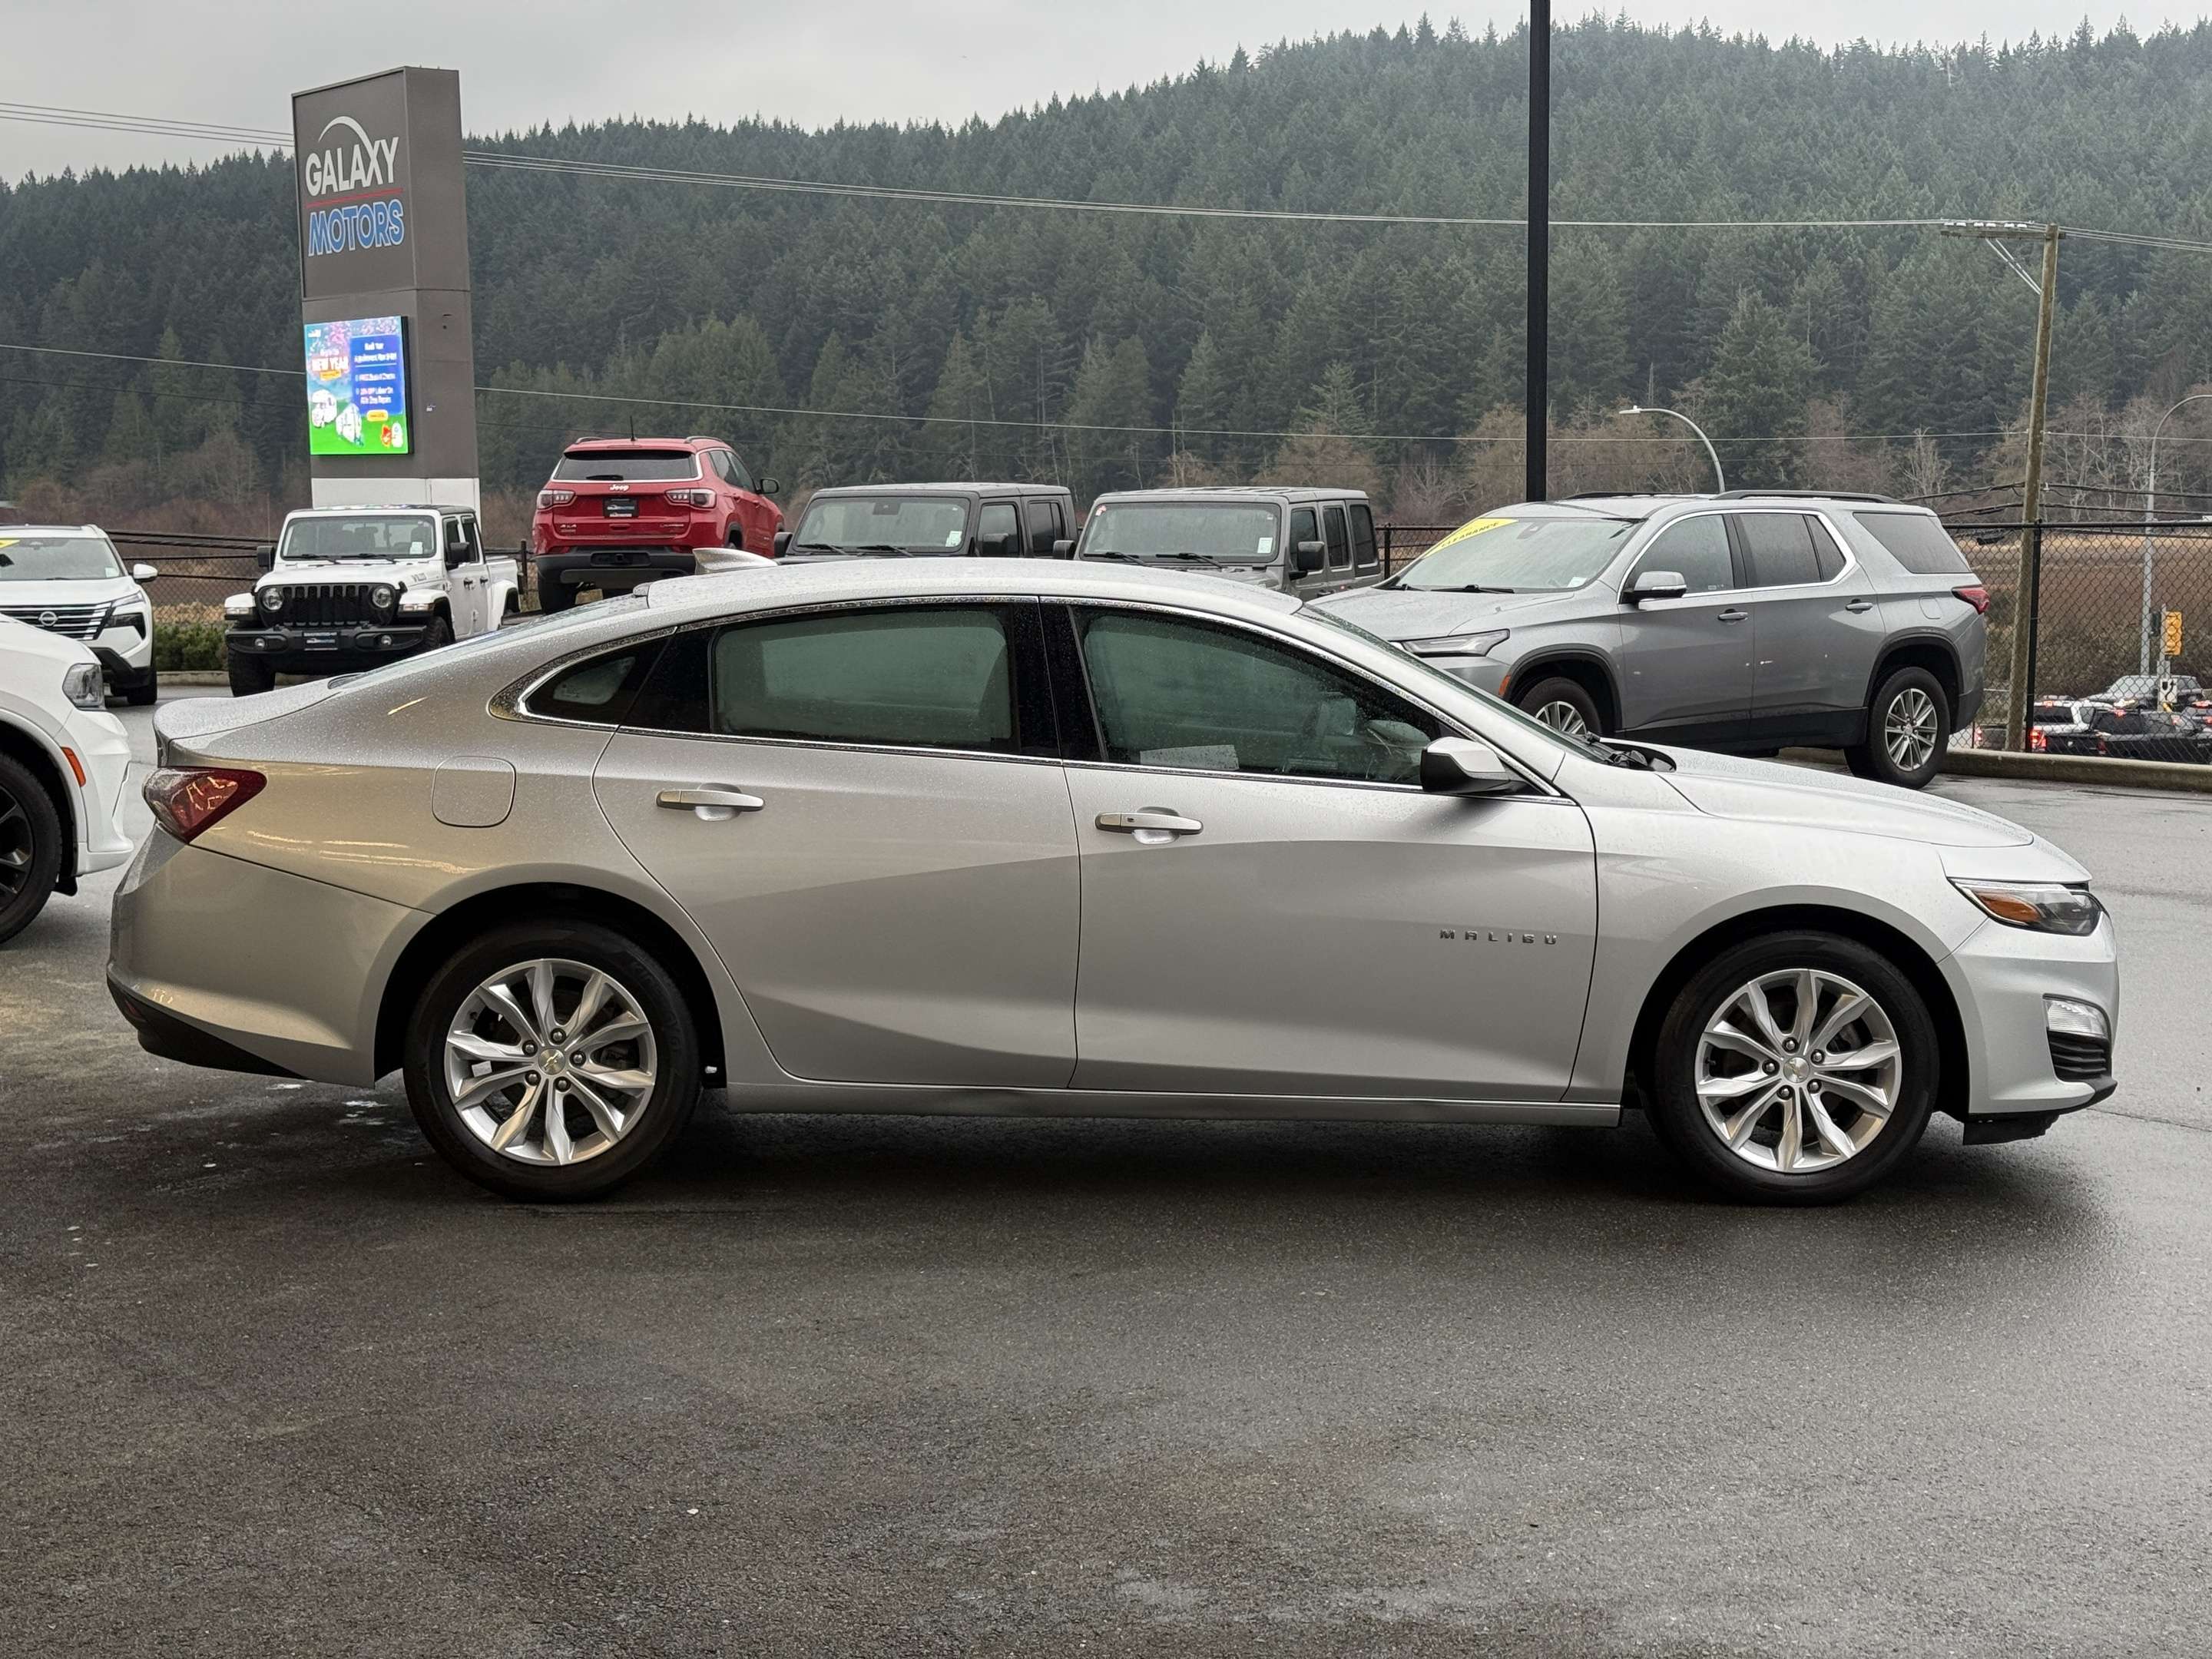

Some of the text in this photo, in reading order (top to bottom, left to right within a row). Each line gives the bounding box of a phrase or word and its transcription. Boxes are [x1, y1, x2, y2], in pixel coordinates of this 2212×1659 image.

[305, 135, 399, 197] GALAXY
[308, 199, 405, 257] MOTORS
[1441, 522, 1499, 548] CLEARANCE
[1439, 929, 1558, 945] MALIBU
